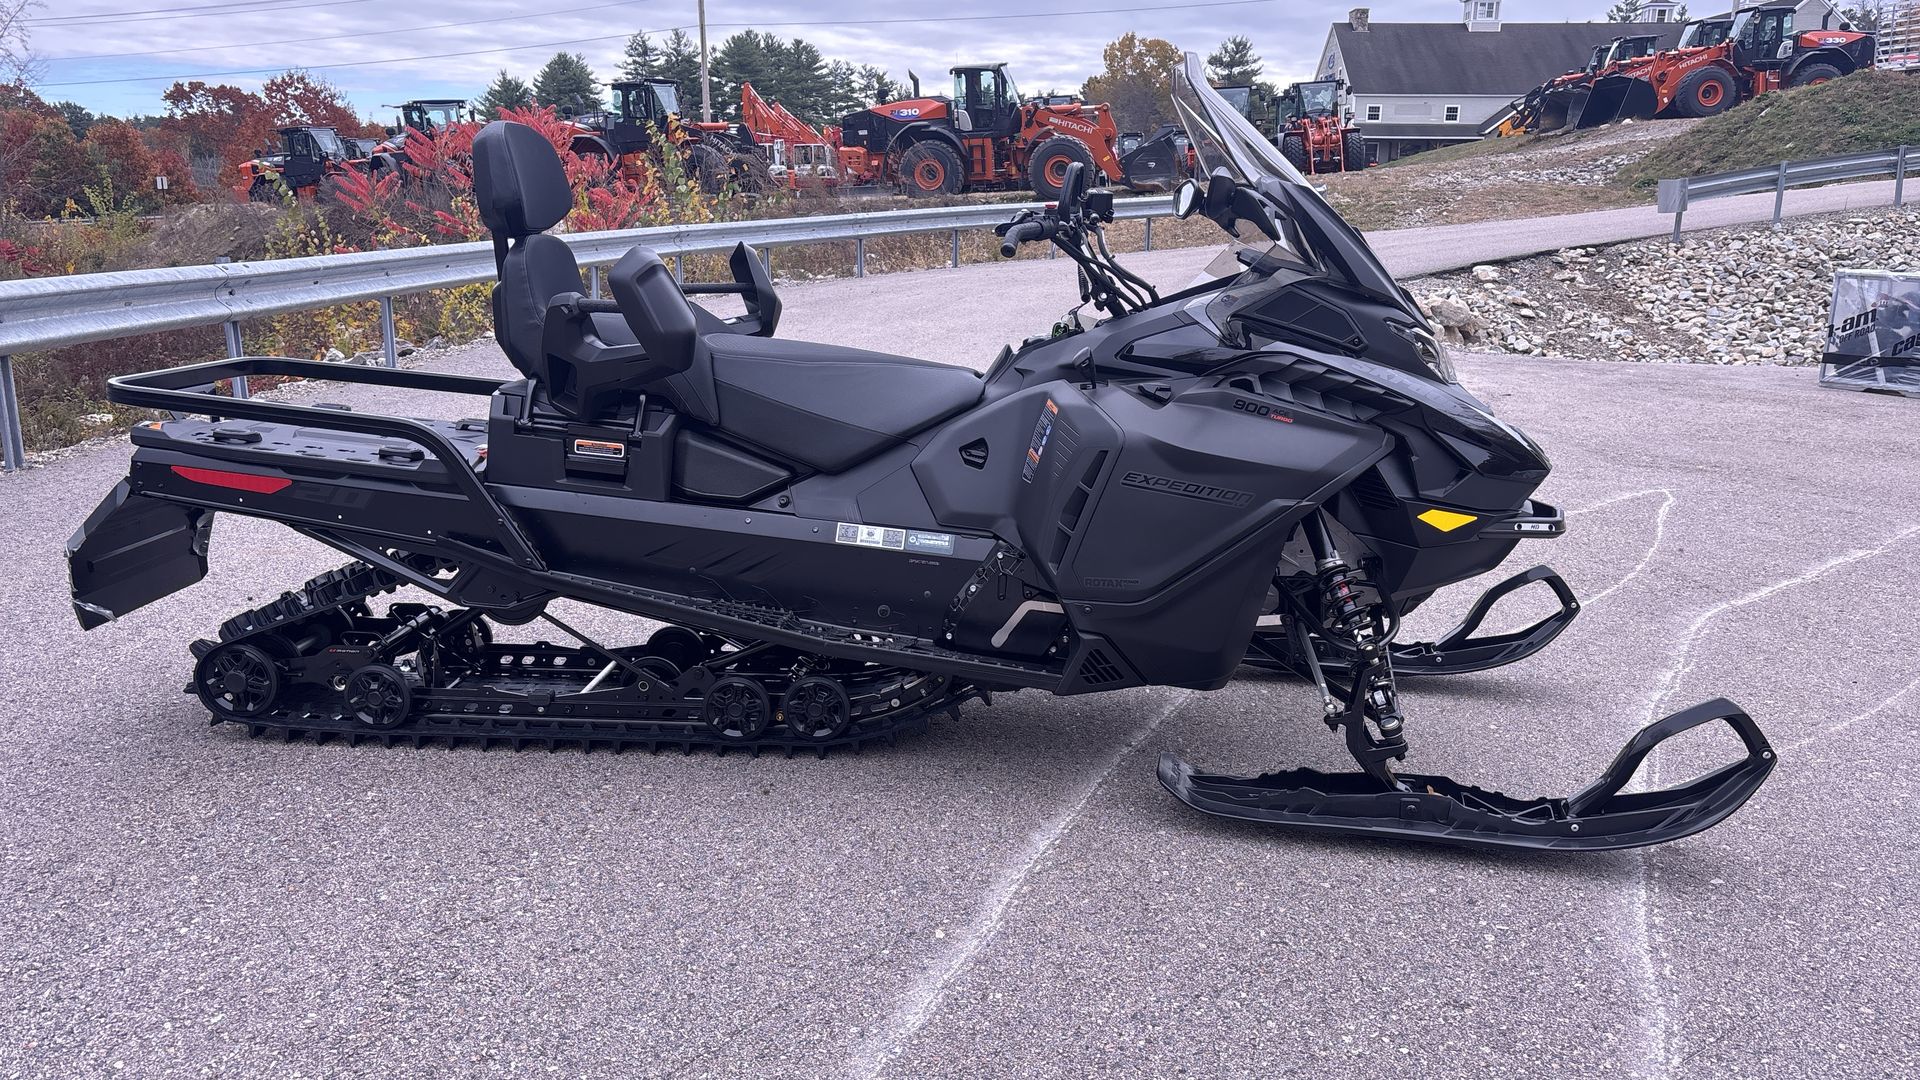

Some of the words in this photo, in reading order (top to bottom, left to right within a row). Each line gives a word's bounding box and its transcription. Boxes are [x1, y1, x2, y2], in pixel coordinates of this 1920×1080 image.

[1678, 54, 1708, 69] HITACHI
[1057, 118, 1093, 135] HITACHI
[709, 135, 738, 158] HITACH
[1839, 331, 1853, 344] OFF
[1855, 324, 1876, 339] ROAD
[1233, 399, 1270, 416] 900
[1270, 413, 1294, 424] TURBO
[1122, 472, 1255, 503] EXPEDITION
